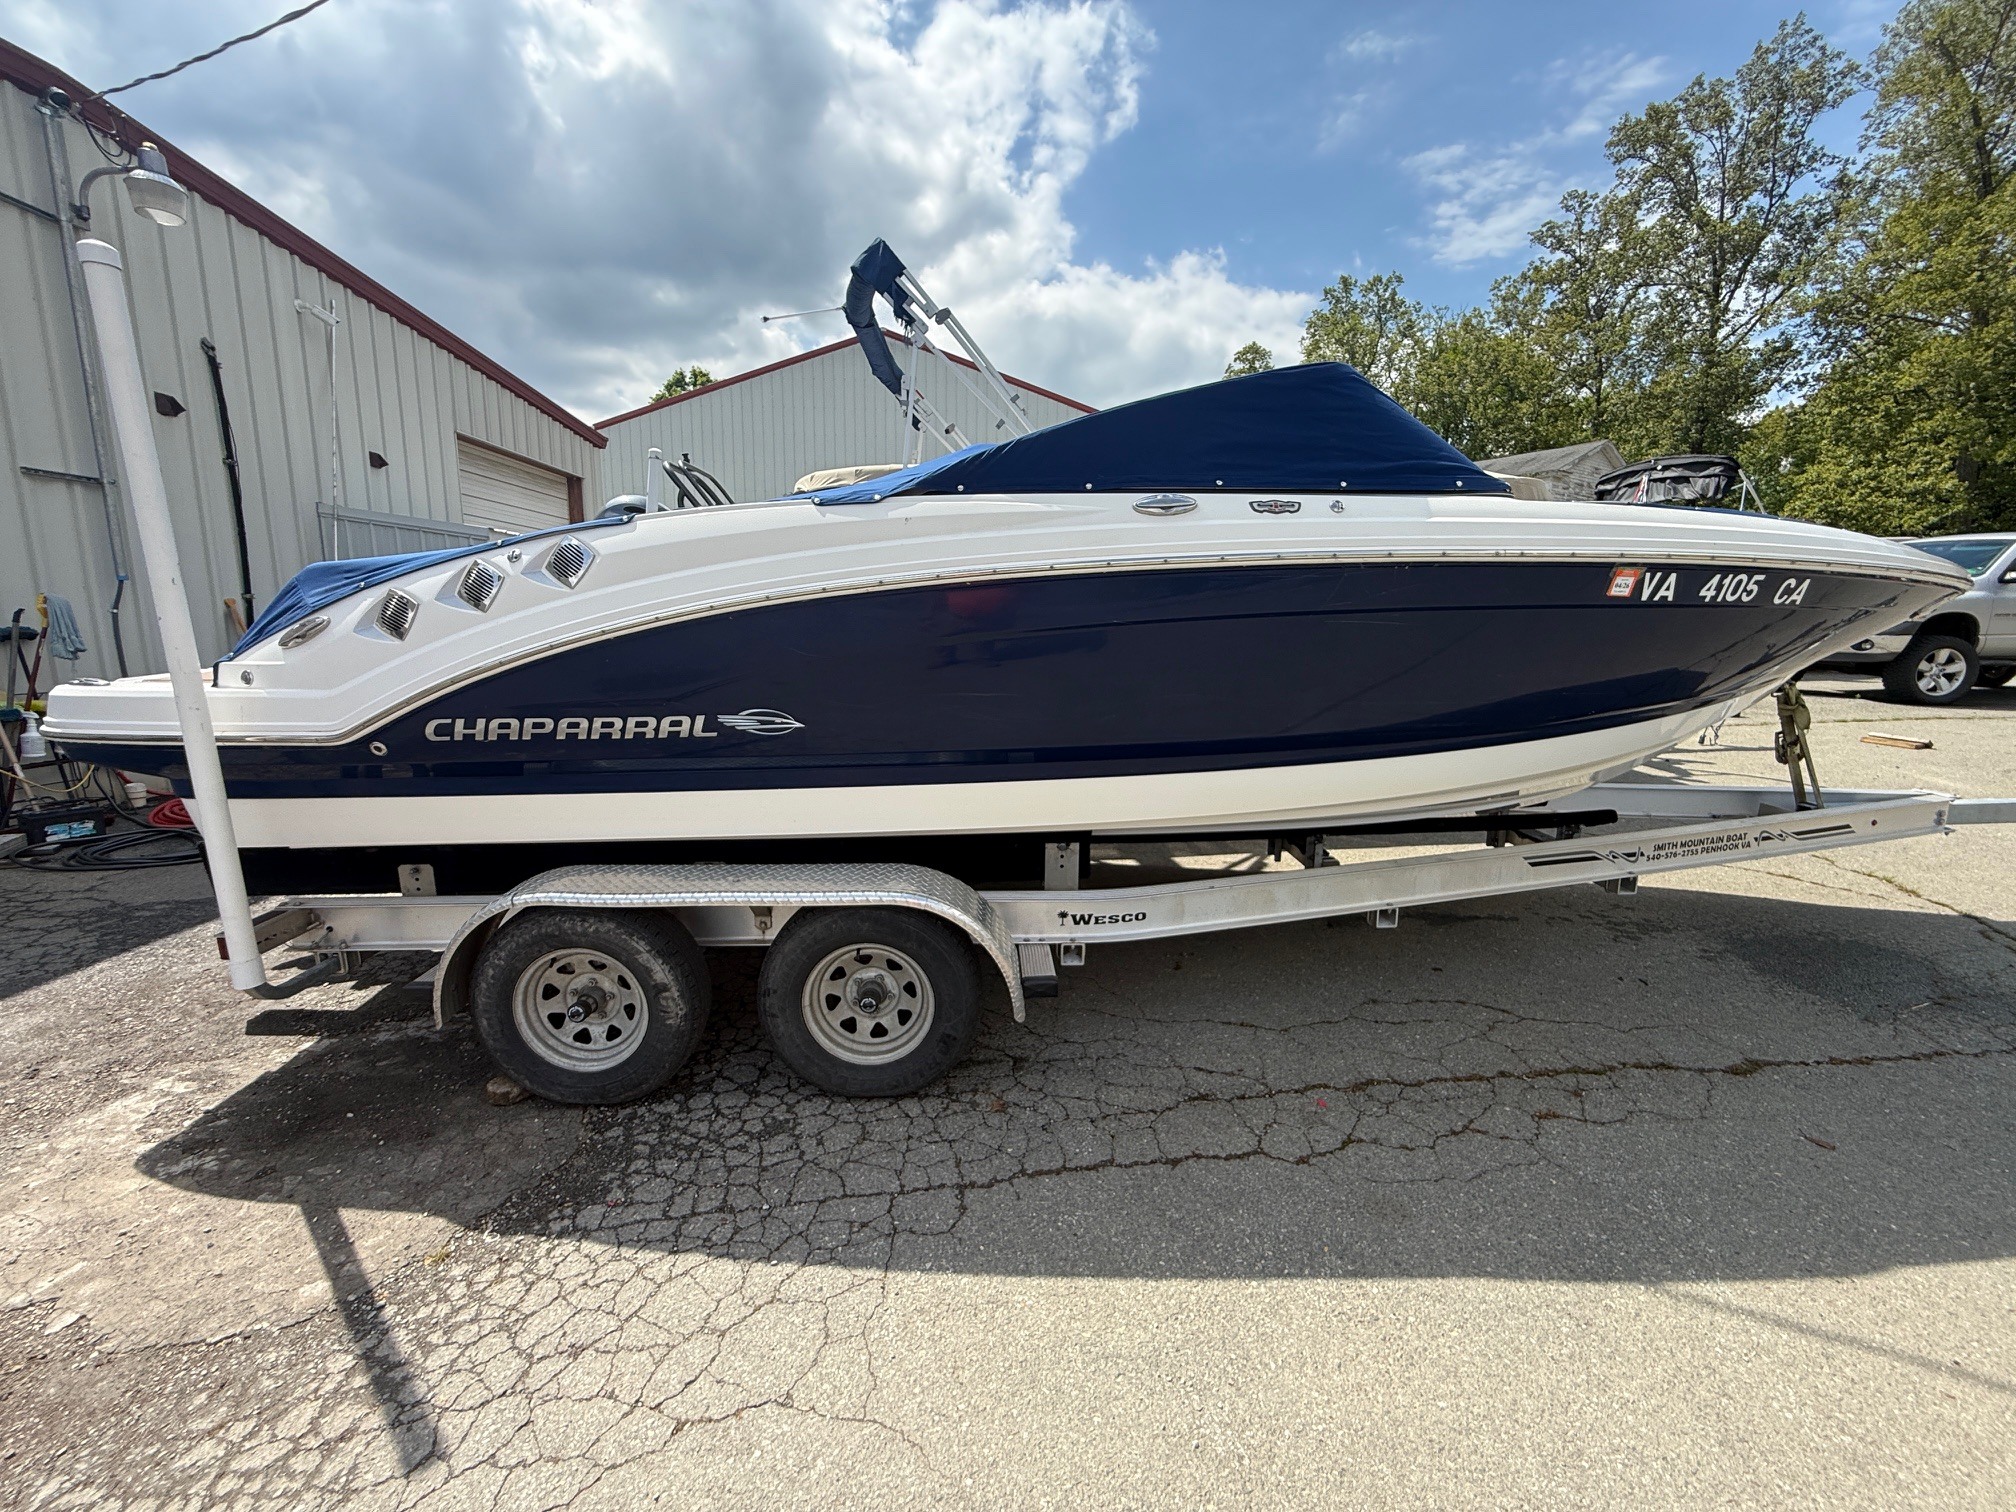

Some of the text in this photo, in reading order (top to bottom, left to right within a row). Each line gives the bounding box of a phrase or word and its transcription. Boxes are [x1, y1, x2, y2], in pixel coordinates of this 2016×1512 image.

[1641, 572, 1811, 605] VA 4105 CA
[424, 715, 718, 742] CHAPARRAL
[1646, 841, 1751, 862] 540-576-2755 PENHOOK VA
[1653, 832, 1748, 852] SMITH MOUNTAIN BOAT
